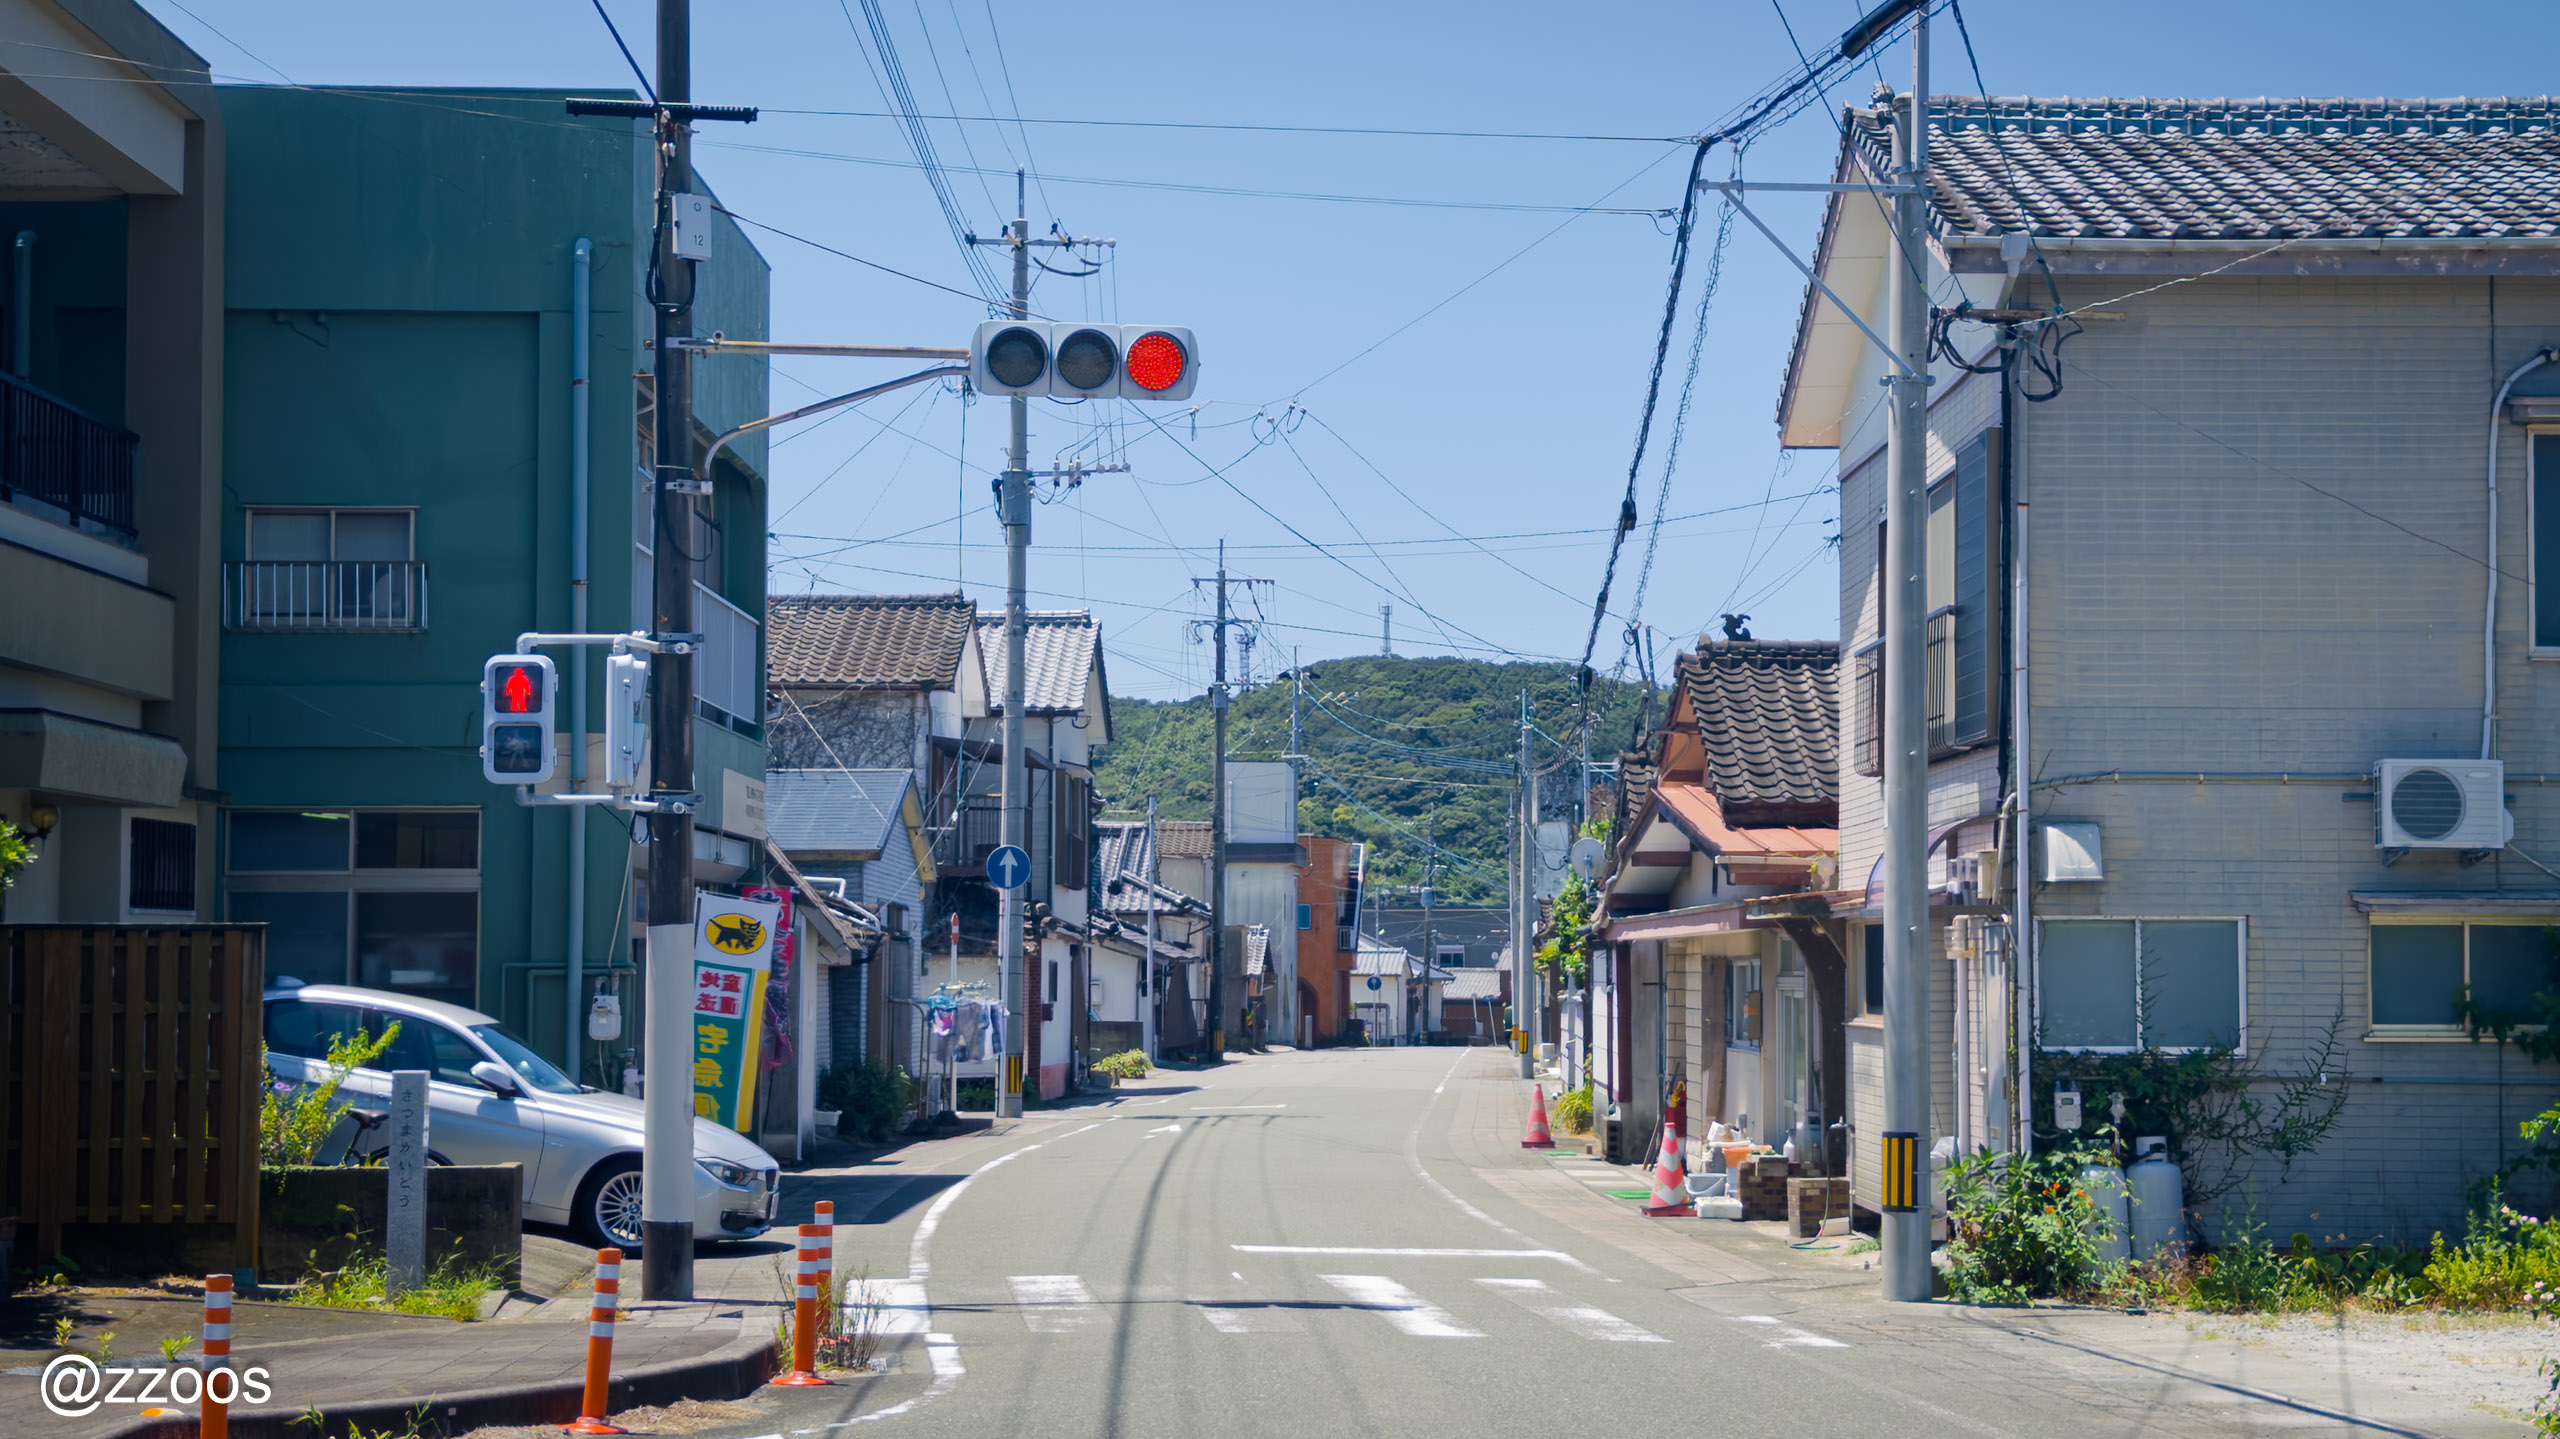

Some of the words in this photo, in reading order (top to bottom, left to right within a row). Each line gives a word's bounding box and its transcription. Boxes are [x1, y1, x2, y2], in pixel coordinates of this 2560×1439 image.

[694, 234, 704, 247] 12
[399, 1091, 414, 1208] さつまかいどう
